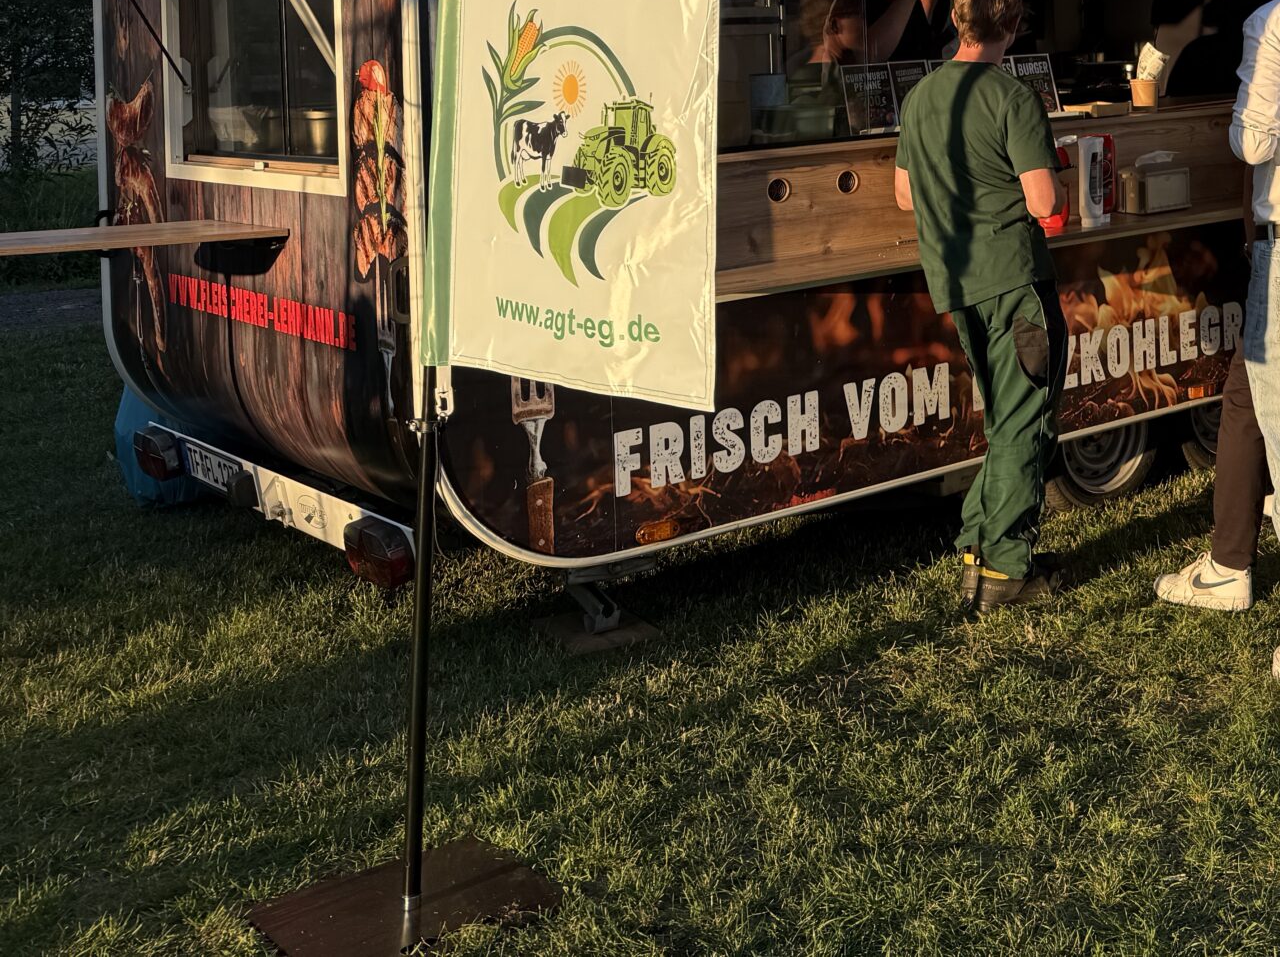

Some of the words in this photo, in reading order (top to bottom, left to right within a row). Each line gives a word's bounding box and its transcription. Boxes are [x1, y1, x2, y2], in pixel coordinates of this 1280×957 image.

[1017, 60, 1049, 77] BURGER
[167, 273, 357, 352] WWW.FLEISCHEREI-LEHMANN.DE
[495, 294, 661, 348] www.agt-eg.de
[612, 389, 821, 497] FRISCH
[843, 362, 950, 440] VOM
